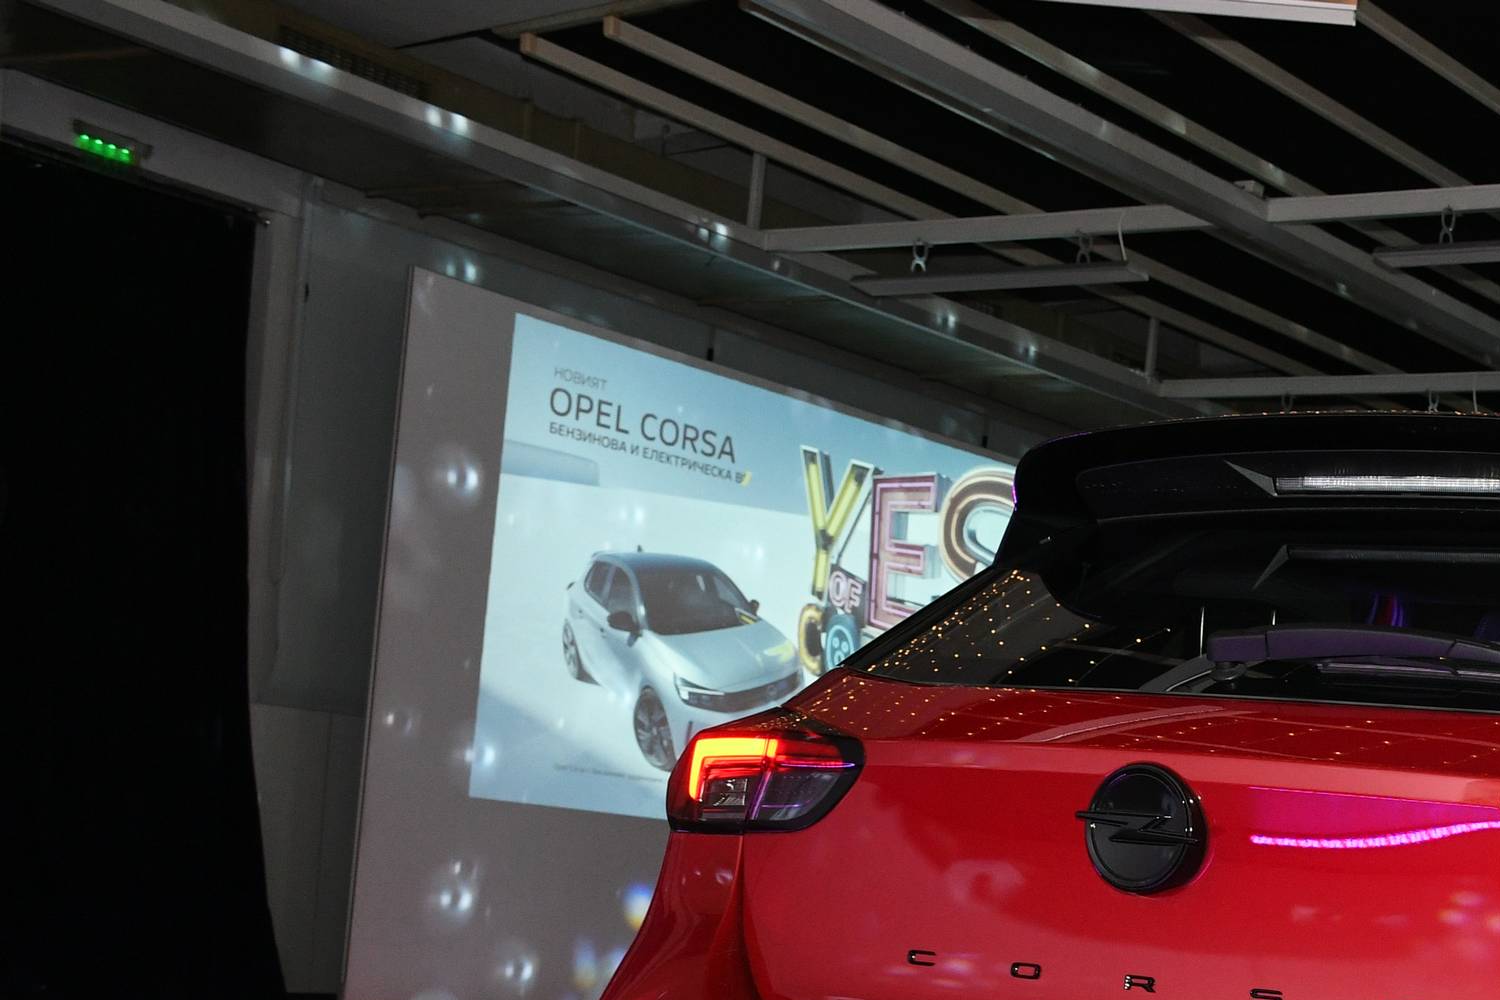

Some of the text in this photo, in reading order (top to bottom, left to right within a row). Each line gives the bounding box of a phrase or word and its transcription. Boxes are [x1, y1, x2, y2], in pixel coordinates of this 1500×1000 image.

[553, 367, 607, 390] НОВИЯТ
[549, 422, 627, 452] БЕНЗИНОВА
[630, 443, 640, 456] И
[642, 447, 732, 482] ЕЛЕКТРИЧЕСКА
[550, 387, 736, 464] OPEL CORSA
